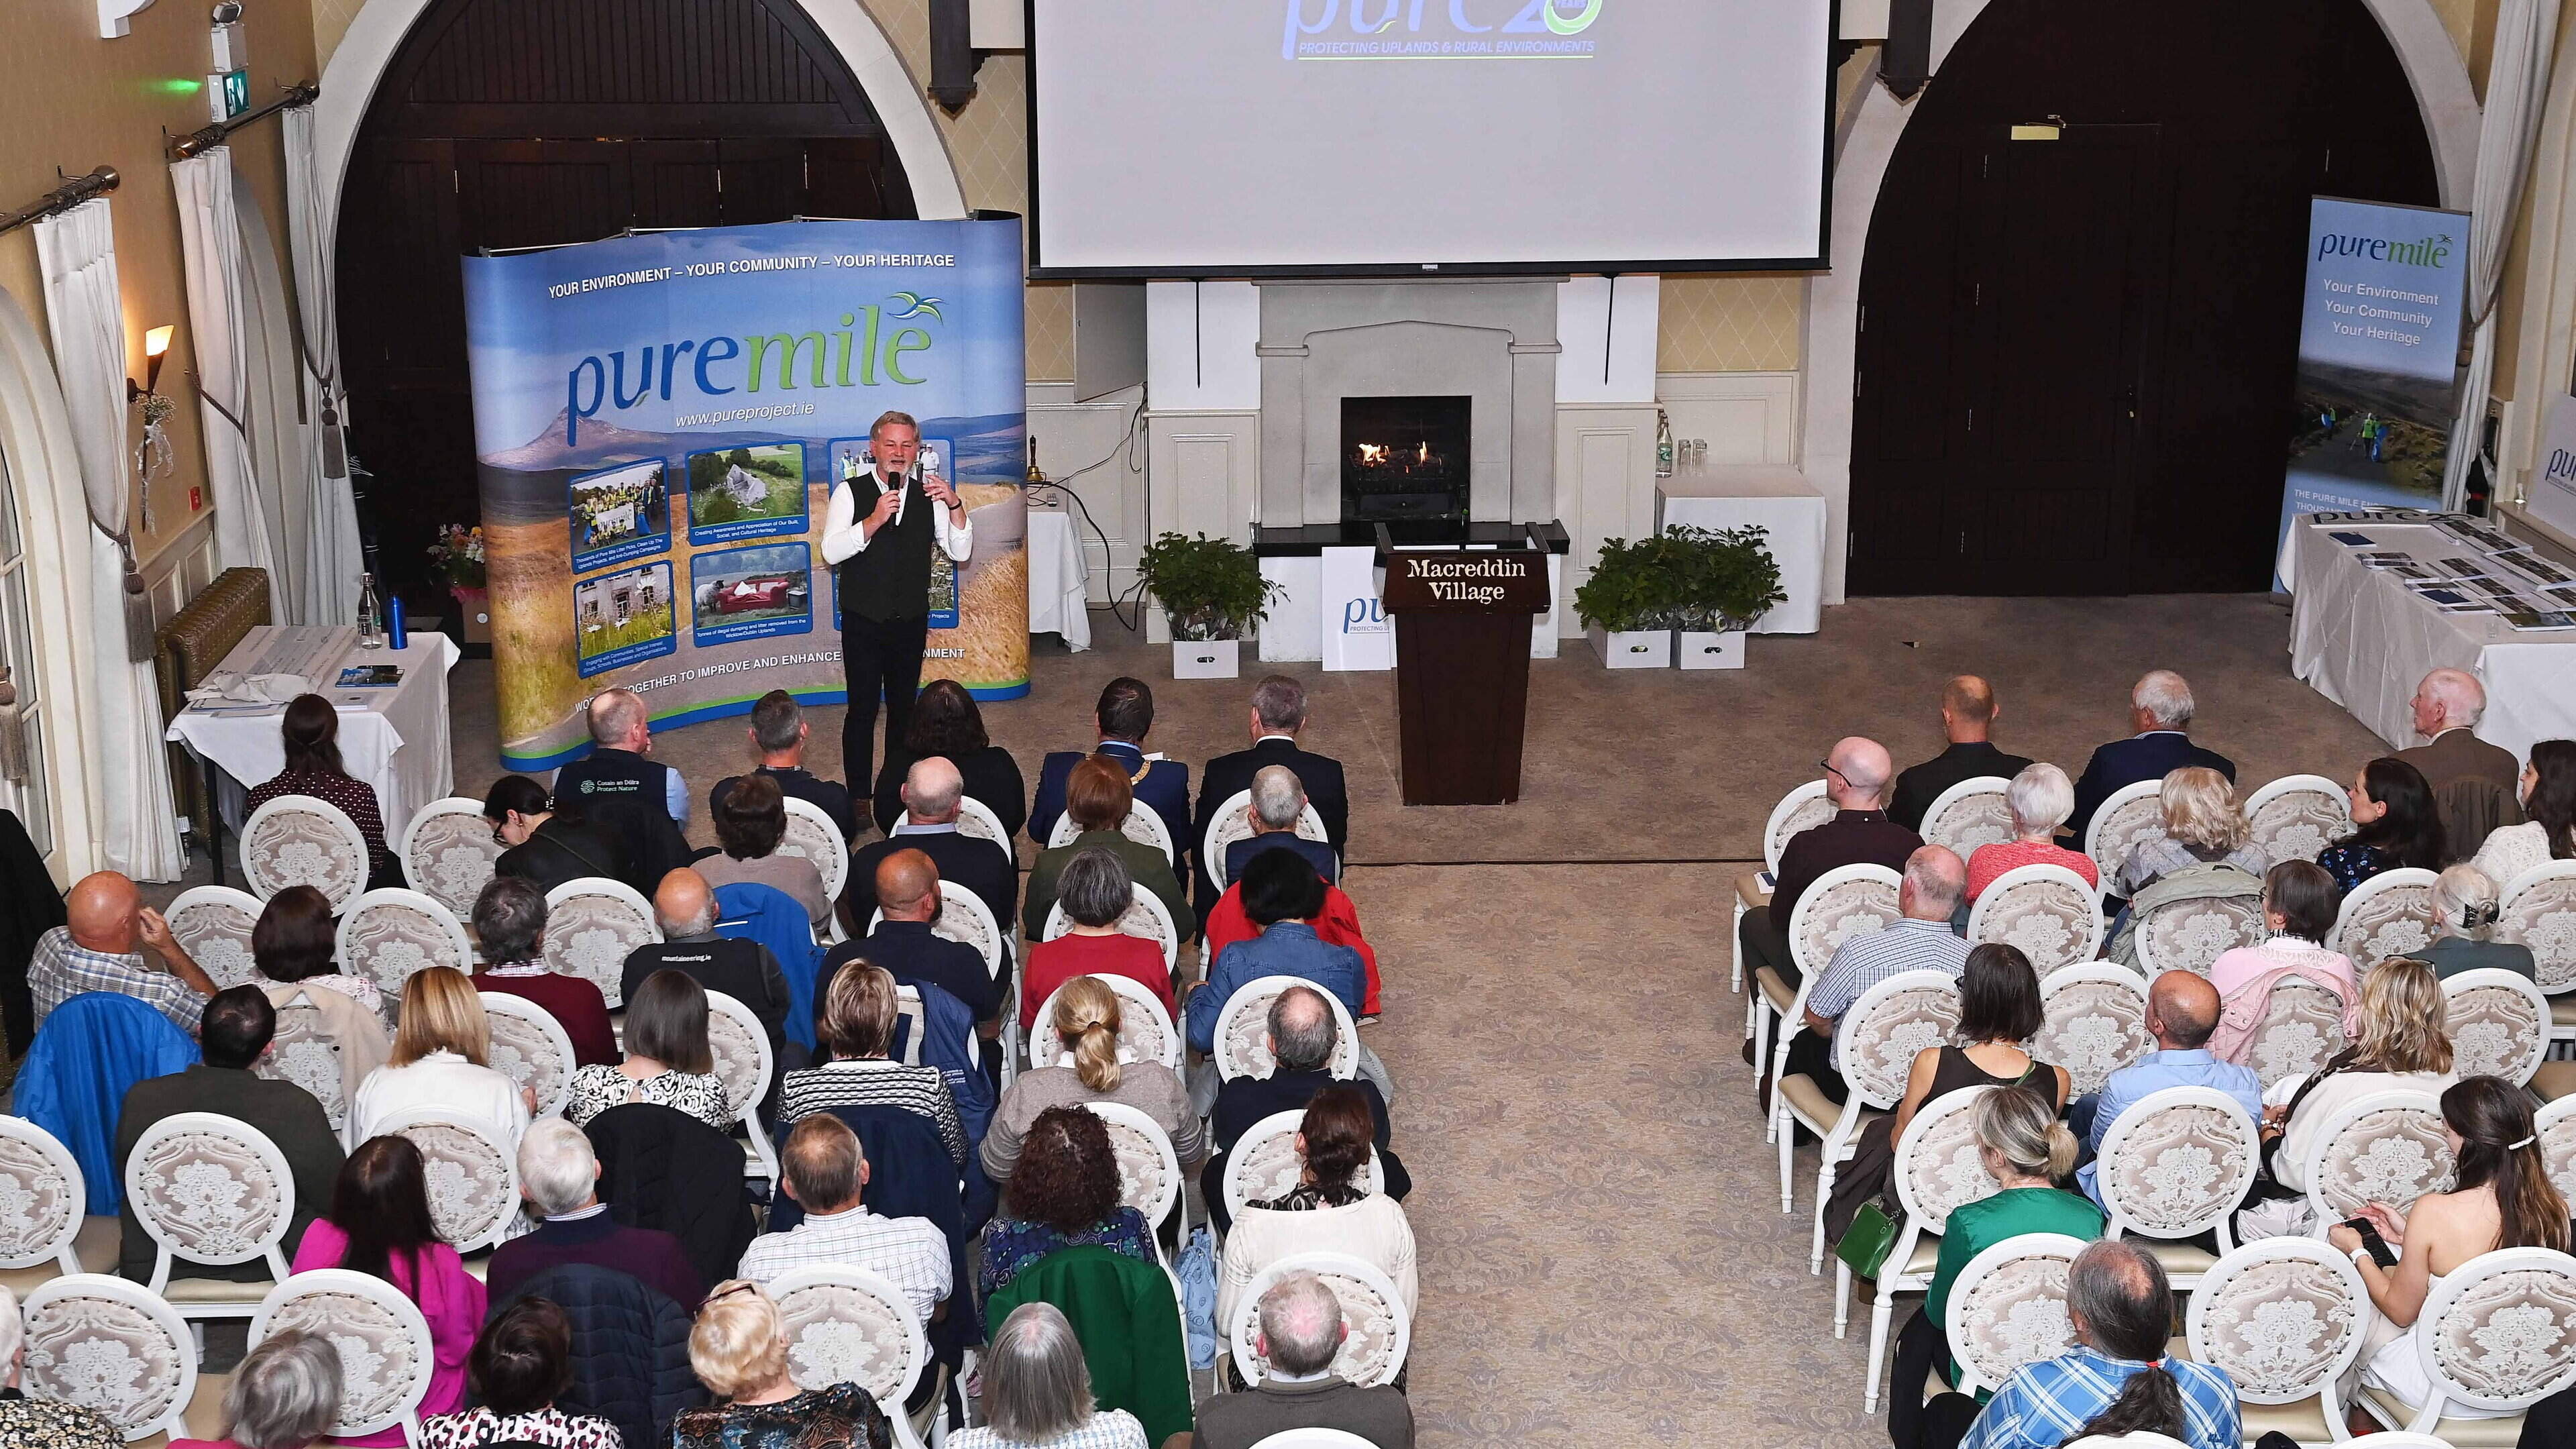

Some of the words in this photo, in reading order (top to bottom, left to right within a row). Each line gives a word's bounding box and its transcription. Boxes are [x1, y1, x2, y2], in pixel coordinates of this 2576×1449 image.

[1299, 42, 1378, 54] PROTECTING
[1382, 41, 1438, 54] UPLANDS
[1442, 42, 1451, 52] &
[1454, 41, 1493, 53] RURAL
[1496, 40, 1595, 52] ENVIRONMENTS
[549, 281, 579, 299] YOUR
[582, 267, 672, 292] ENVIRONMENT
[686, 261, 725, 276] YOUR
[729, 256, 818, 273] COMMUNITY
[834, 255, 875, 268] YOUR
[881, 254, 955, 267] HERITAGE
[2324, 278, 2353, 293] Your
[2357, 283, 2439, 305] Environment
[2325, 300, 2354, 314] Your
[2359, 305, 2432, 327] Community
[2333, 321, 2363, 335] Your
[2367, 327, 2420, 346] Heritage
[675, 402, 814, 428] www.pureproject.ie
[2294, 489, 2310, 499] THE
[2312, 492, 2336, 504] PURE
[2338, 496, 2359, 507] MILE
[2296, 501, 2347, 513] THOUS
[1407, 558, 1526, 578] Macreddin
[1428, 581, 1505, 604] Village
[623, 674, 677, 695] OGETHER
[680, 669, 694, 683] TO
[698, 660, 750, 679] IMPROVE
[753, 656, 779, 669] AND
[782, 651, 842, 665] ENHANCE
